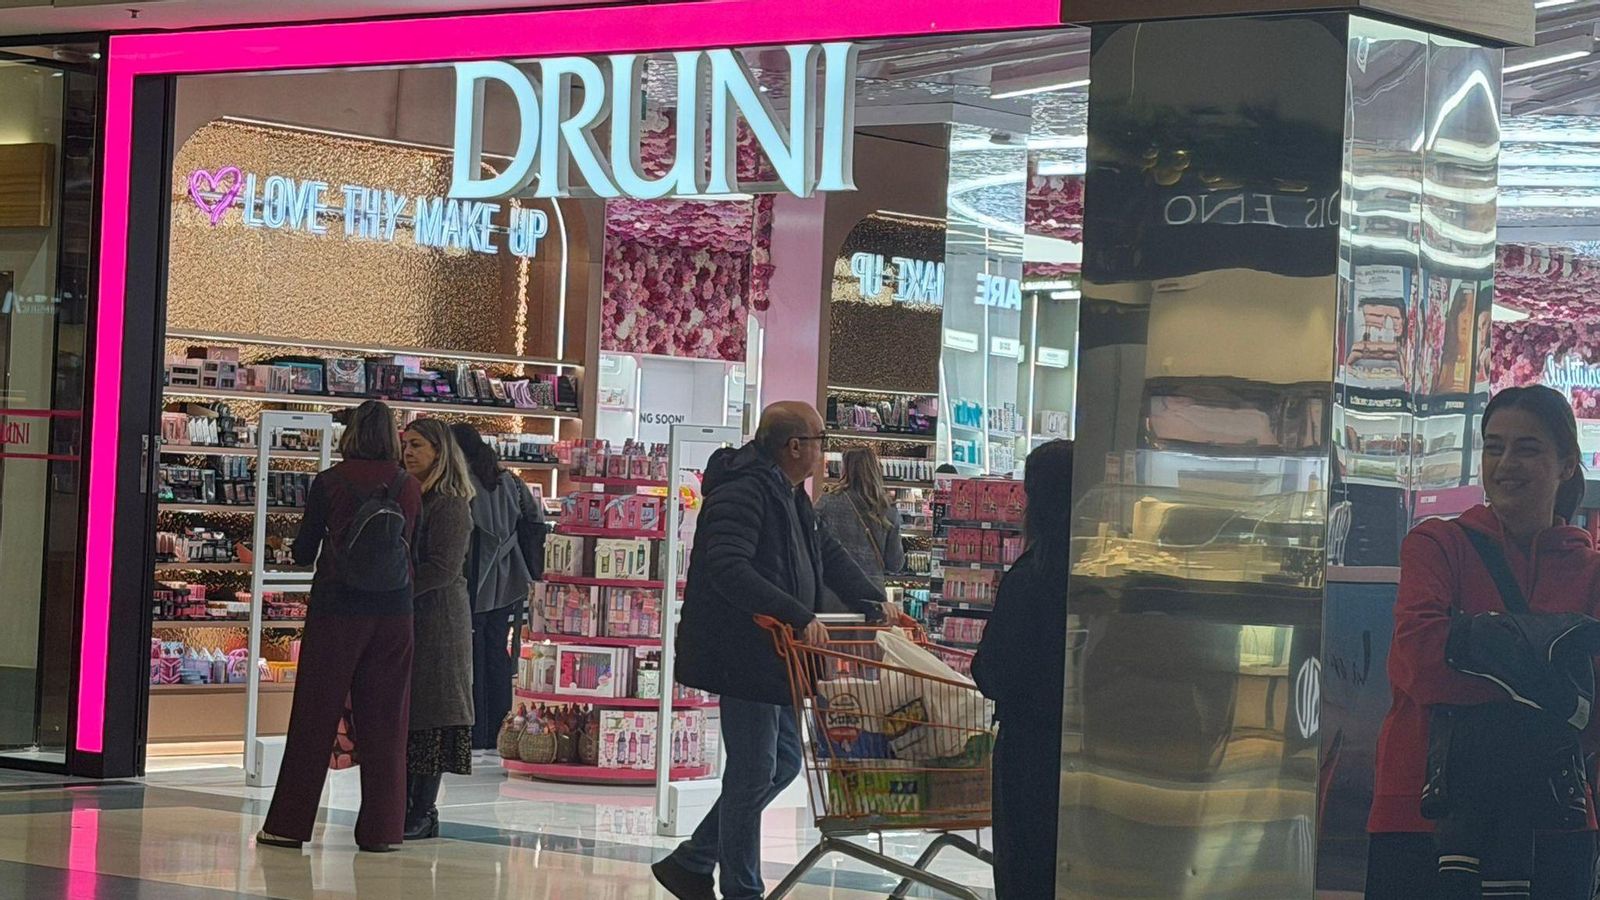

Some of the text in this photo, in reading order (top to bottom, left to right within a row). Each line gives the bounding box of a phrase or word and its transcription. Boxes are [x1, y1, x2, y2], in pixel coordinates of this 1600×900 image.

[447, 42, 857, 198] DRUNI
[244, 173, 549, 257] LOVE THY MAKE UP
